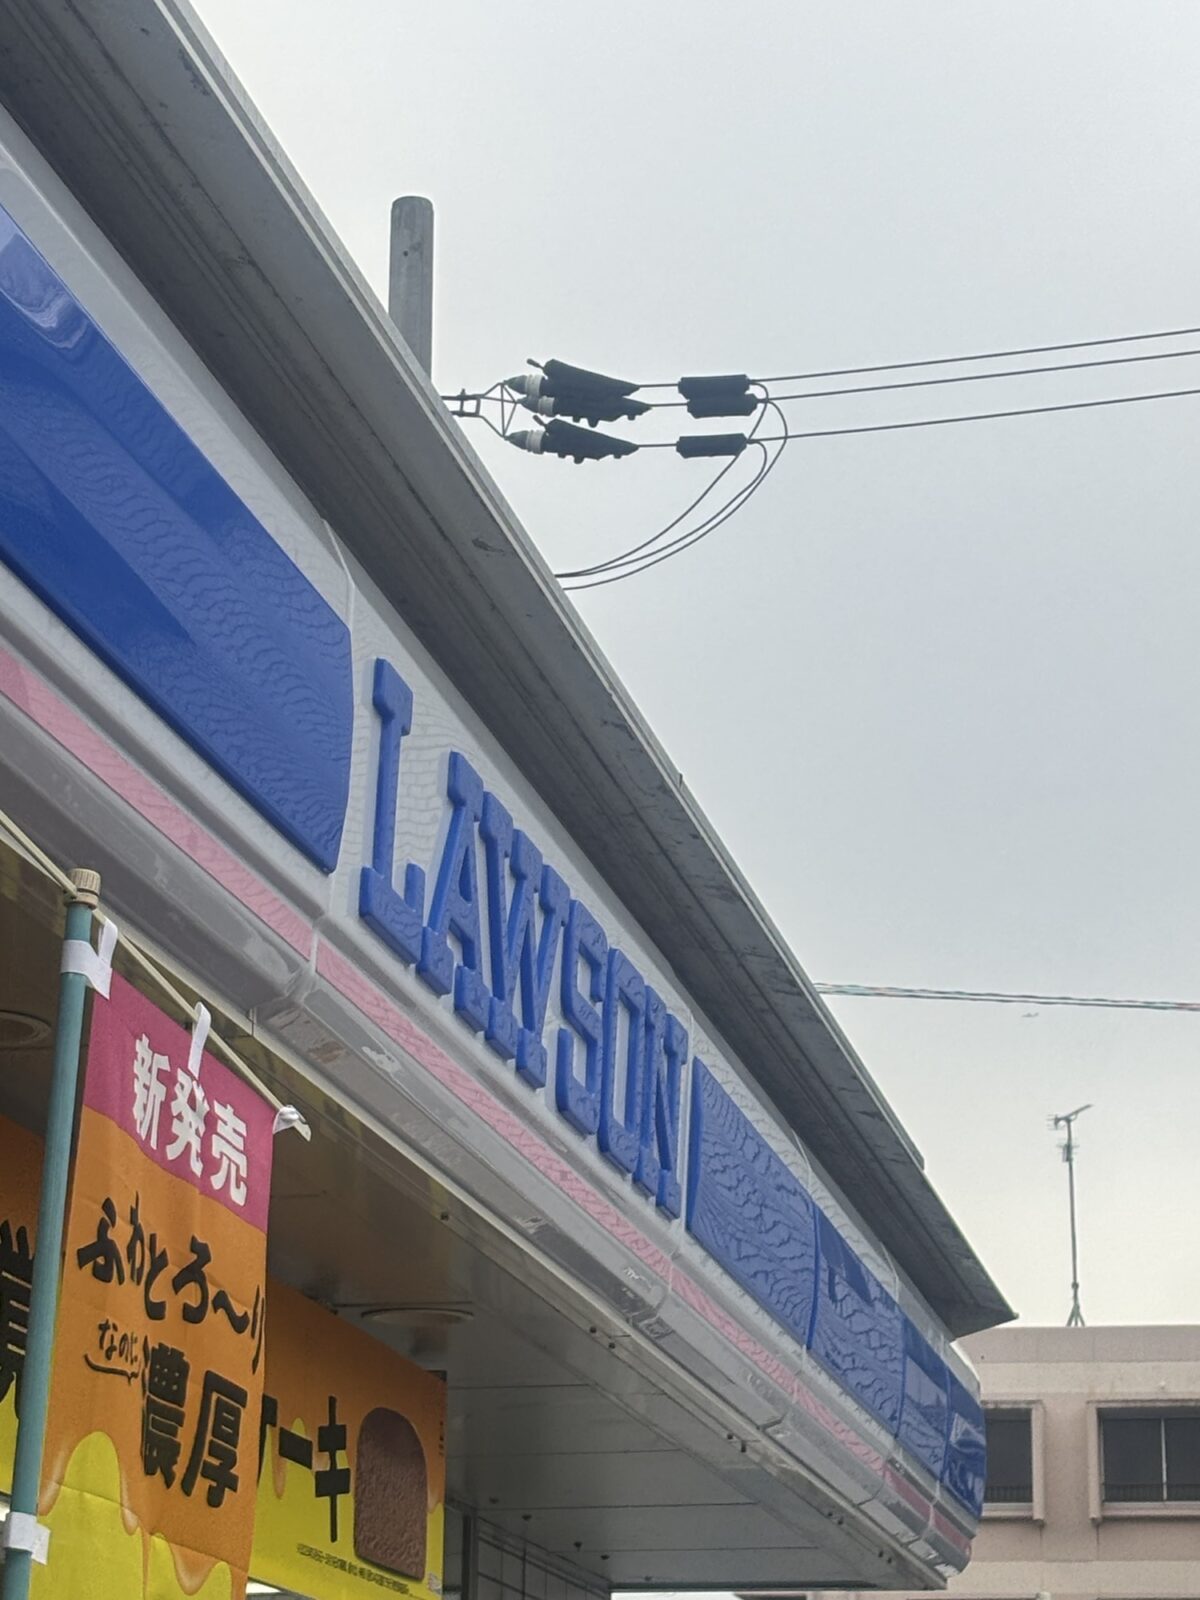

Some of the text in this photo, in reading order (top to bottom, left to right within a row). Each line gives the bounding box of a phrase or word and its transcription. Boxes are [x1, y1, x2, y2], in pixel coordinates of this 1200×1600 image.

[358, 657, 689, 1221] LAWSON
[132, 1033, 248, 1207] 新発売
[98, 1318, 138, 1365] なのに
[140, 1335, 248, 1508] 濃厚
